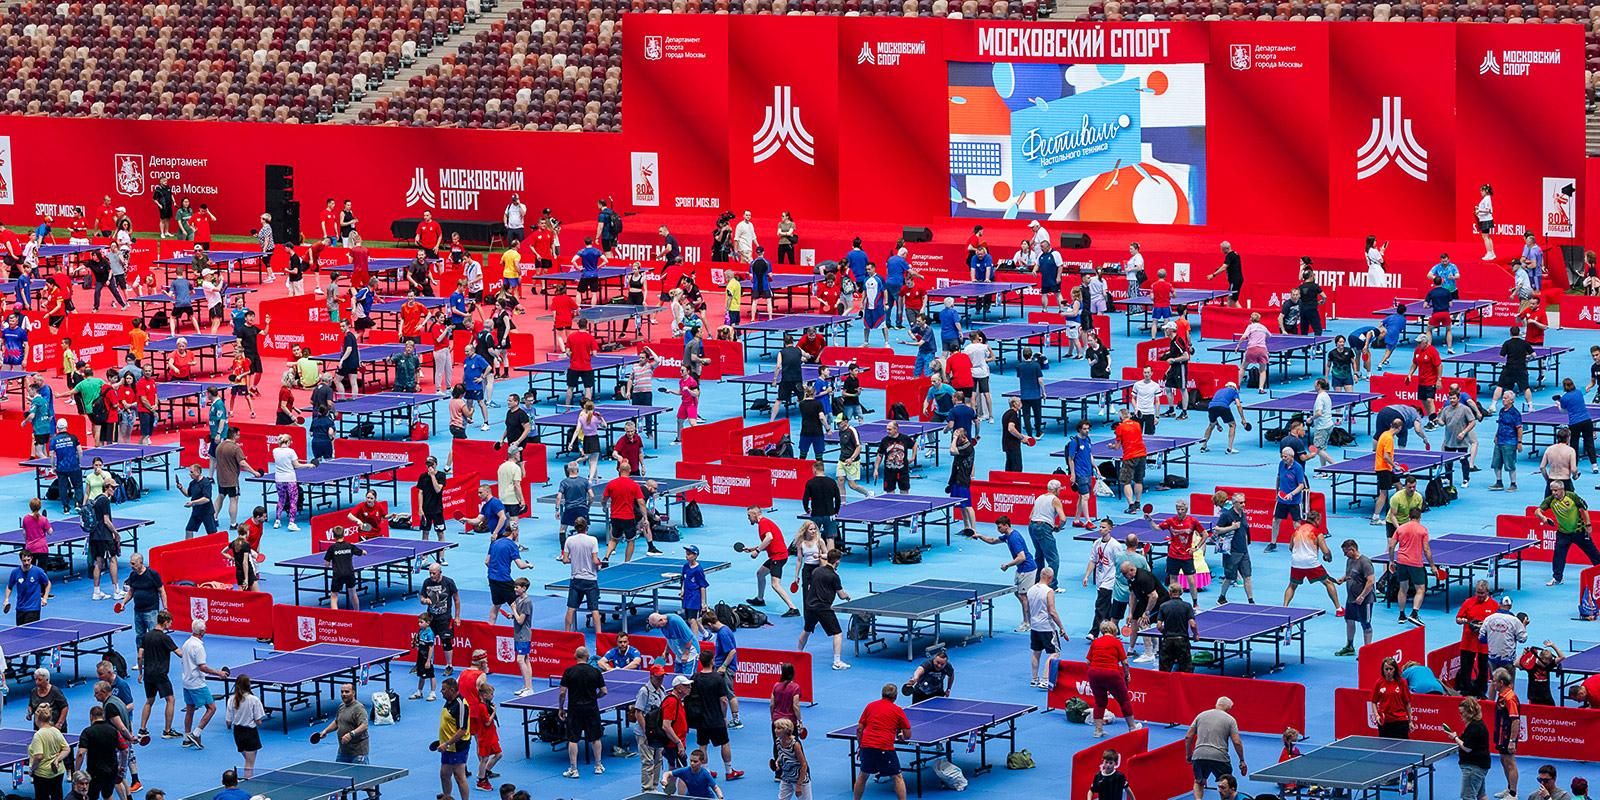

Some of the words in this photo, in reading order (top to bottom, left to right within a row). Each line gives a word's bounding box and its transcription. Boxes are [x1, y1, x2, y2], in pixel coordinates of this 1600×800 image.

[665, 36, 700, 44] Департамент
[978, 25, 1104, 57] МОСКОВСКИЙ
[1110, 28, 1170, 57] СПОРТ
[877, 40, 926, 55] МОСКОВСКИЙ
[1255, 44, 1296, 52] Департамент
[877, 54, 900, 66] СПОРТ
[1503, 49, 1560, 64] МОСКОВСКИЙ
[1503, 64, 1529, 76] СПОРТ
[1021, 113, 1120, 162] Фестиваль
[149, 156, 208, 169] Департамент
[1040, 149, 1080, 166] Настольного
[150, 171, 180, 180] спорта
[439, 167, 524, 192] МОСКОВСКИЙ
[150, 185, 183, 195] года
[184, 184, 218, 194] Москвы
[440, 190, 480, 211] СПОРТ
[675, 196, 720, 208] SPORT.MOS.RU
[770, 468, 798, 480] КОВСКИЙ
[712, 476, 750, 488] МОСКОВСКИЙ
[712, 486, 730, 495] СПОРТ
[994, 492, 1036, 504] МОСКОВСКИЙ
[994, 502, 1014, 513] СПОРТ
[210, 600, 244, 608] Департамент
[538, 656, 560, 664] Москвы
[736, 662, 784, 676] МОСКОВСКИЙ
[735, 672, 758, 684] СПОРТ
[1530, 716, 1576, 727] Департамент
[1531, 726, 1556, 734] спорта
[1532, 734, 1556, 743] города
[1557, 735, 1584, 744] Москвы
